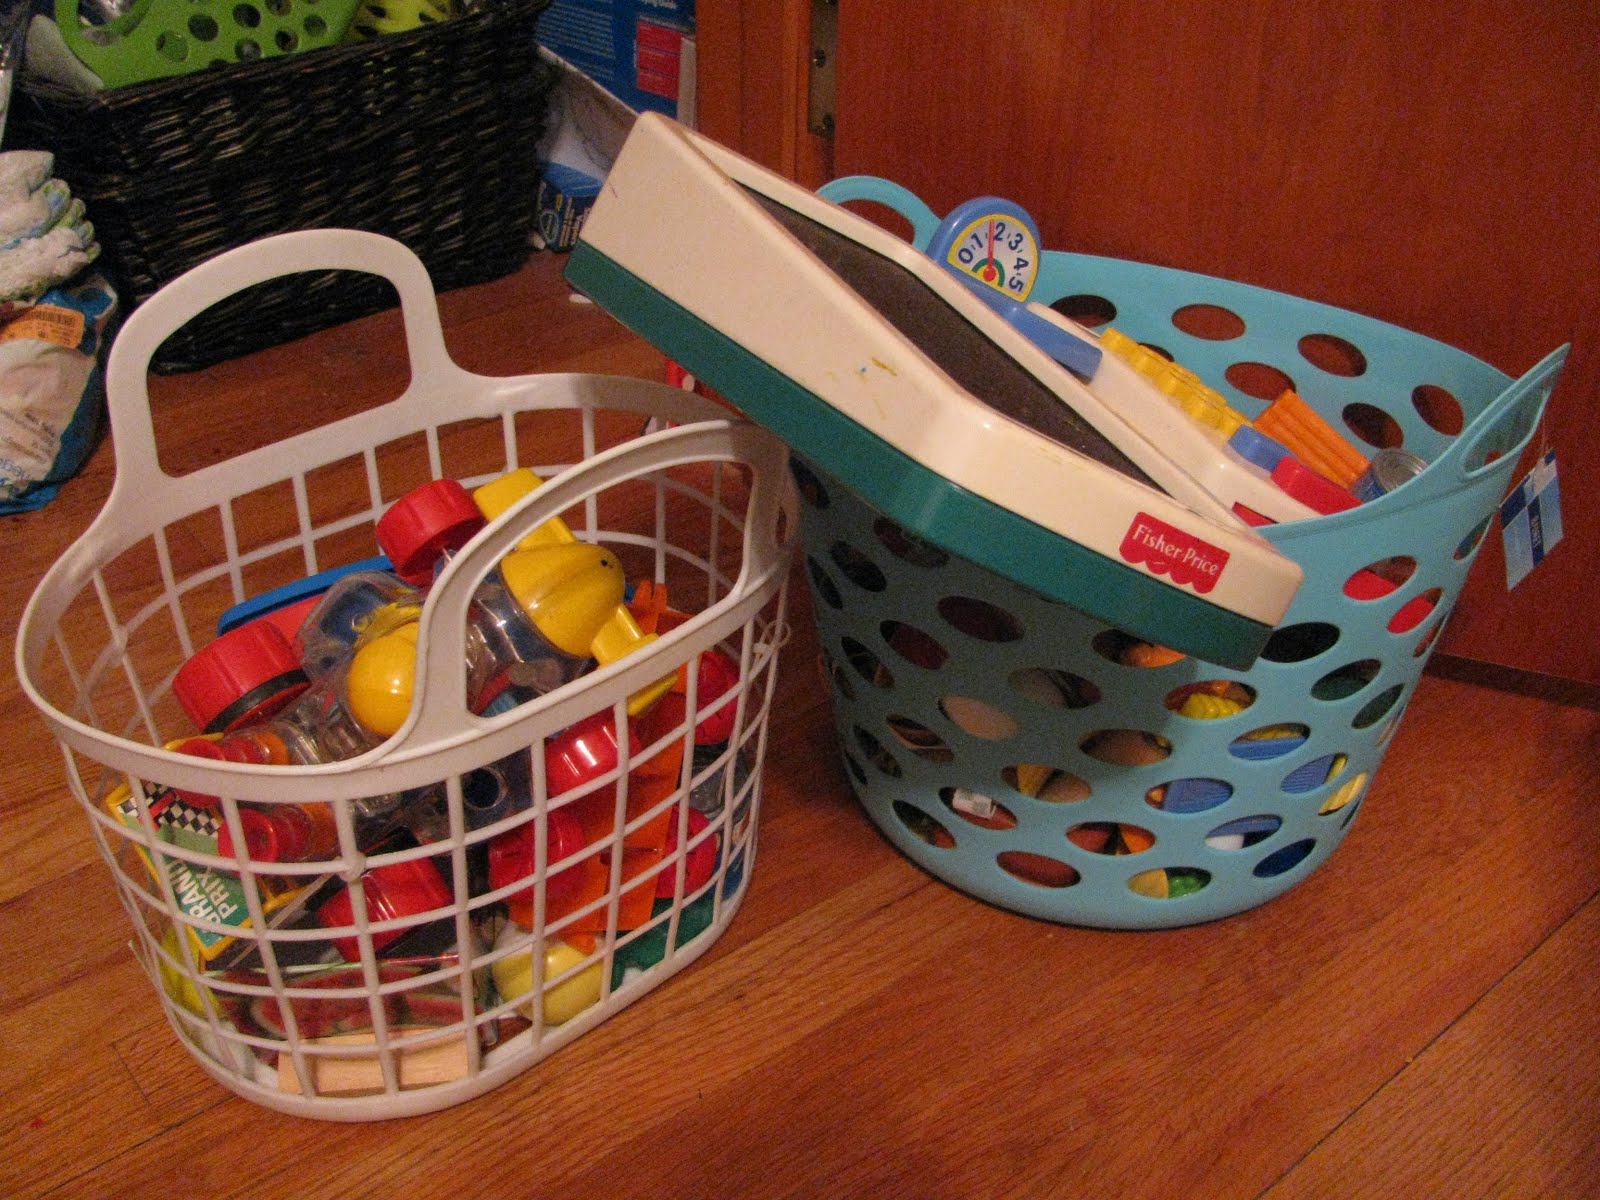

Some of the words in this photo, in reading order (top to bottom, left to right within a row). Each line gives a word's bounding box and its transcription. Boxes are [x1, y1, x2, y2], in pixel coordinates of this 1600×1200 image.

[970, 232, 984, 249] 1
[993, 222, 1006, 242] 2
[1008, 232, 1024, 251] 3
[958, 247, 974, 264] 0
[1013, 257, 1029, 271] 4
[1008, 276, 1024, 292] 5
[1132, 523, 1182, 559] Fisher
[1182, 547, 1219, 576] Price
[195, 865, 238, 920] PRIX
